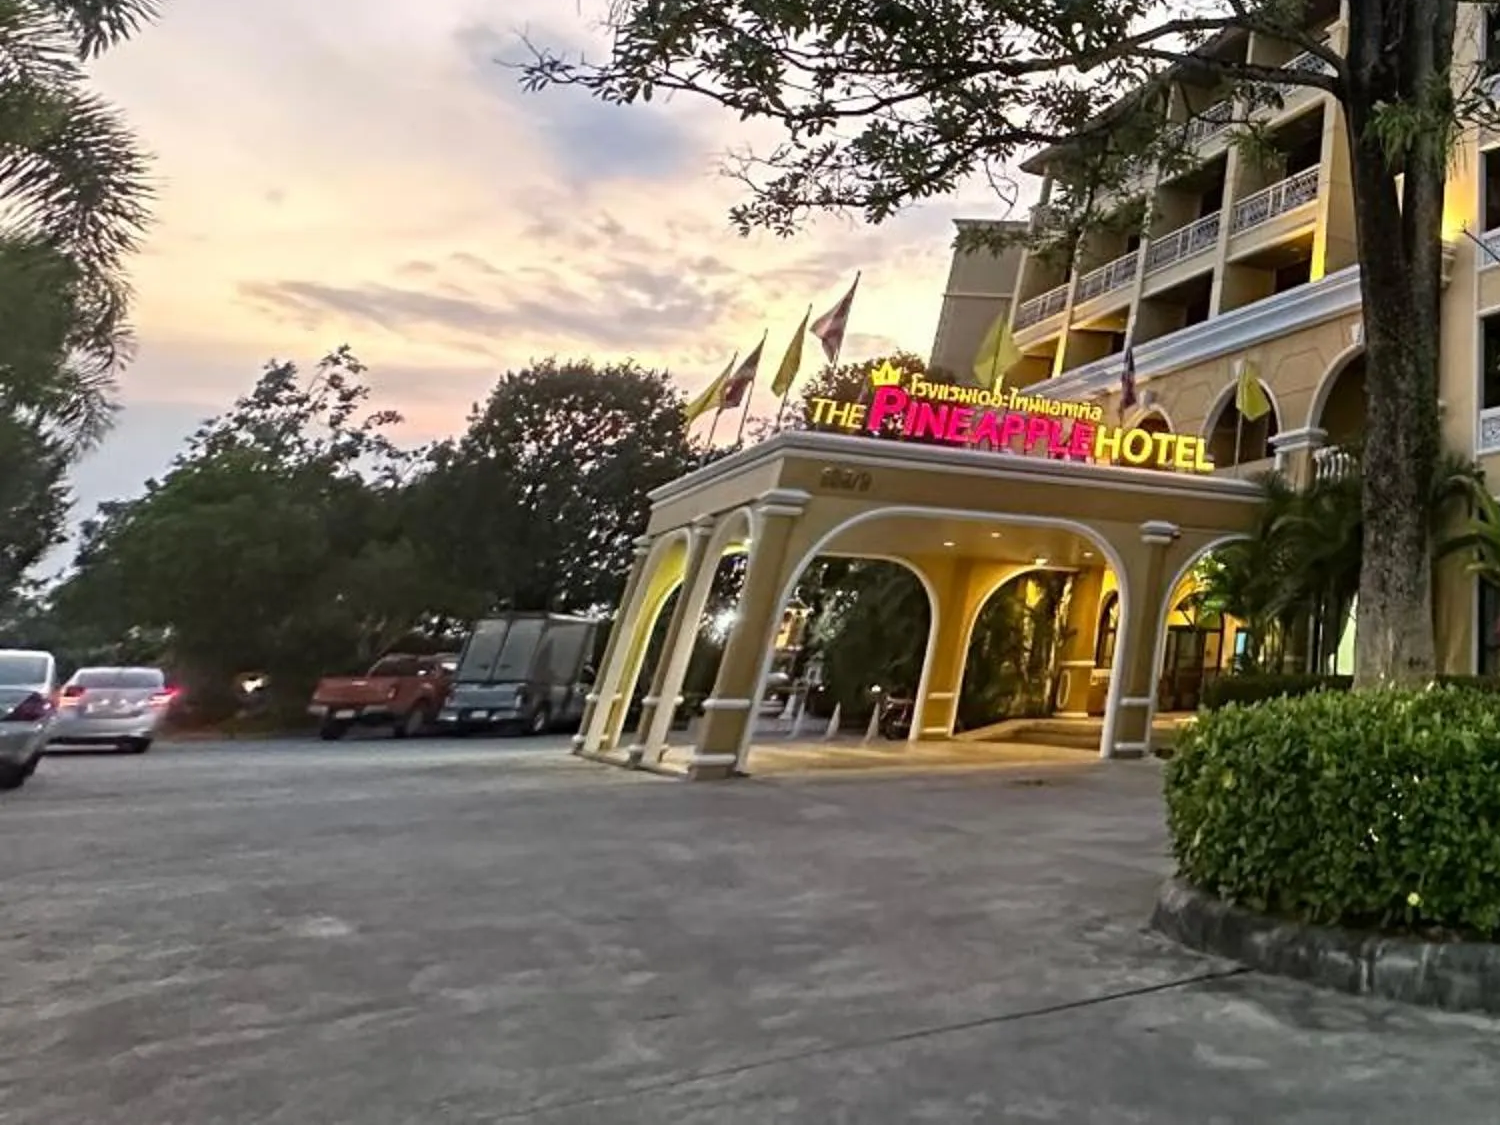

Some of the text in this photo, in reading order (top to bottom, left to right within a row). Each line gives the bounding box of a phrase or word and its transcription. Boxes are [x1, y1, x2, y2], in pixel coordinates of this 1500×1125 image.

[811, 385, 1215, 472] THE PINEAPPLE HOTEL
